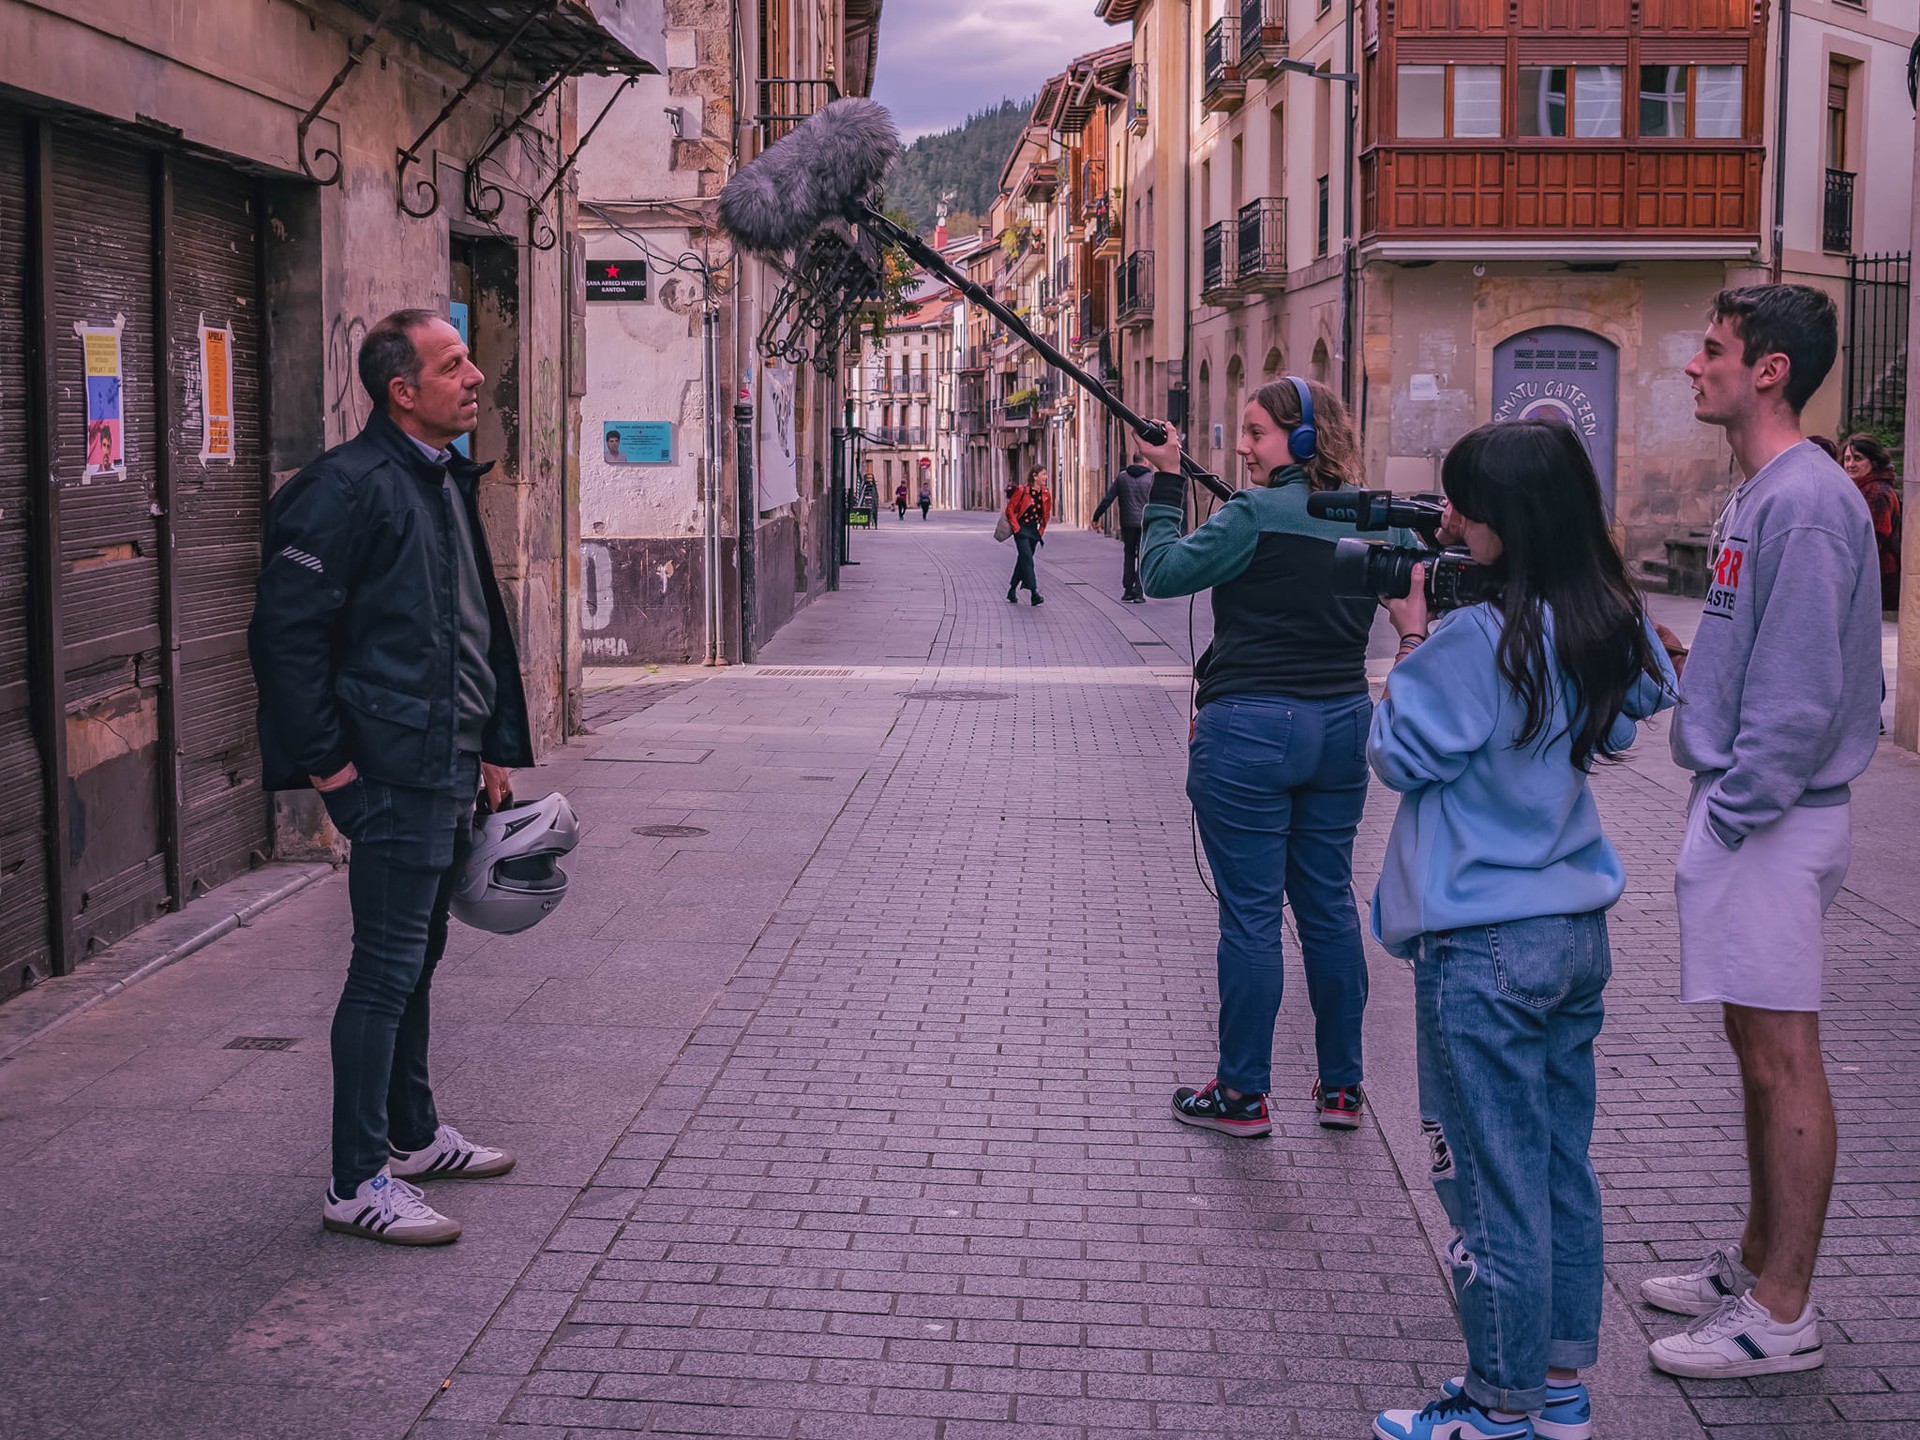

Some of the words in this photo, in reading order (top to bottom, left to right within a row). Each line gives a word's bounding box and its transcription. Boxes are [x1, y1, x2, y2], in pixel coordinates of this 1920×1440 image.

[1494, 382, 1538, 422] RMATU
[1544, 381, 1596, 436] GAITEZEN
[1325, 507, 1358, 520] RØD
[1712, 547, 1743, 589] RR
[1706, 588, 1736, 611] ASTE
